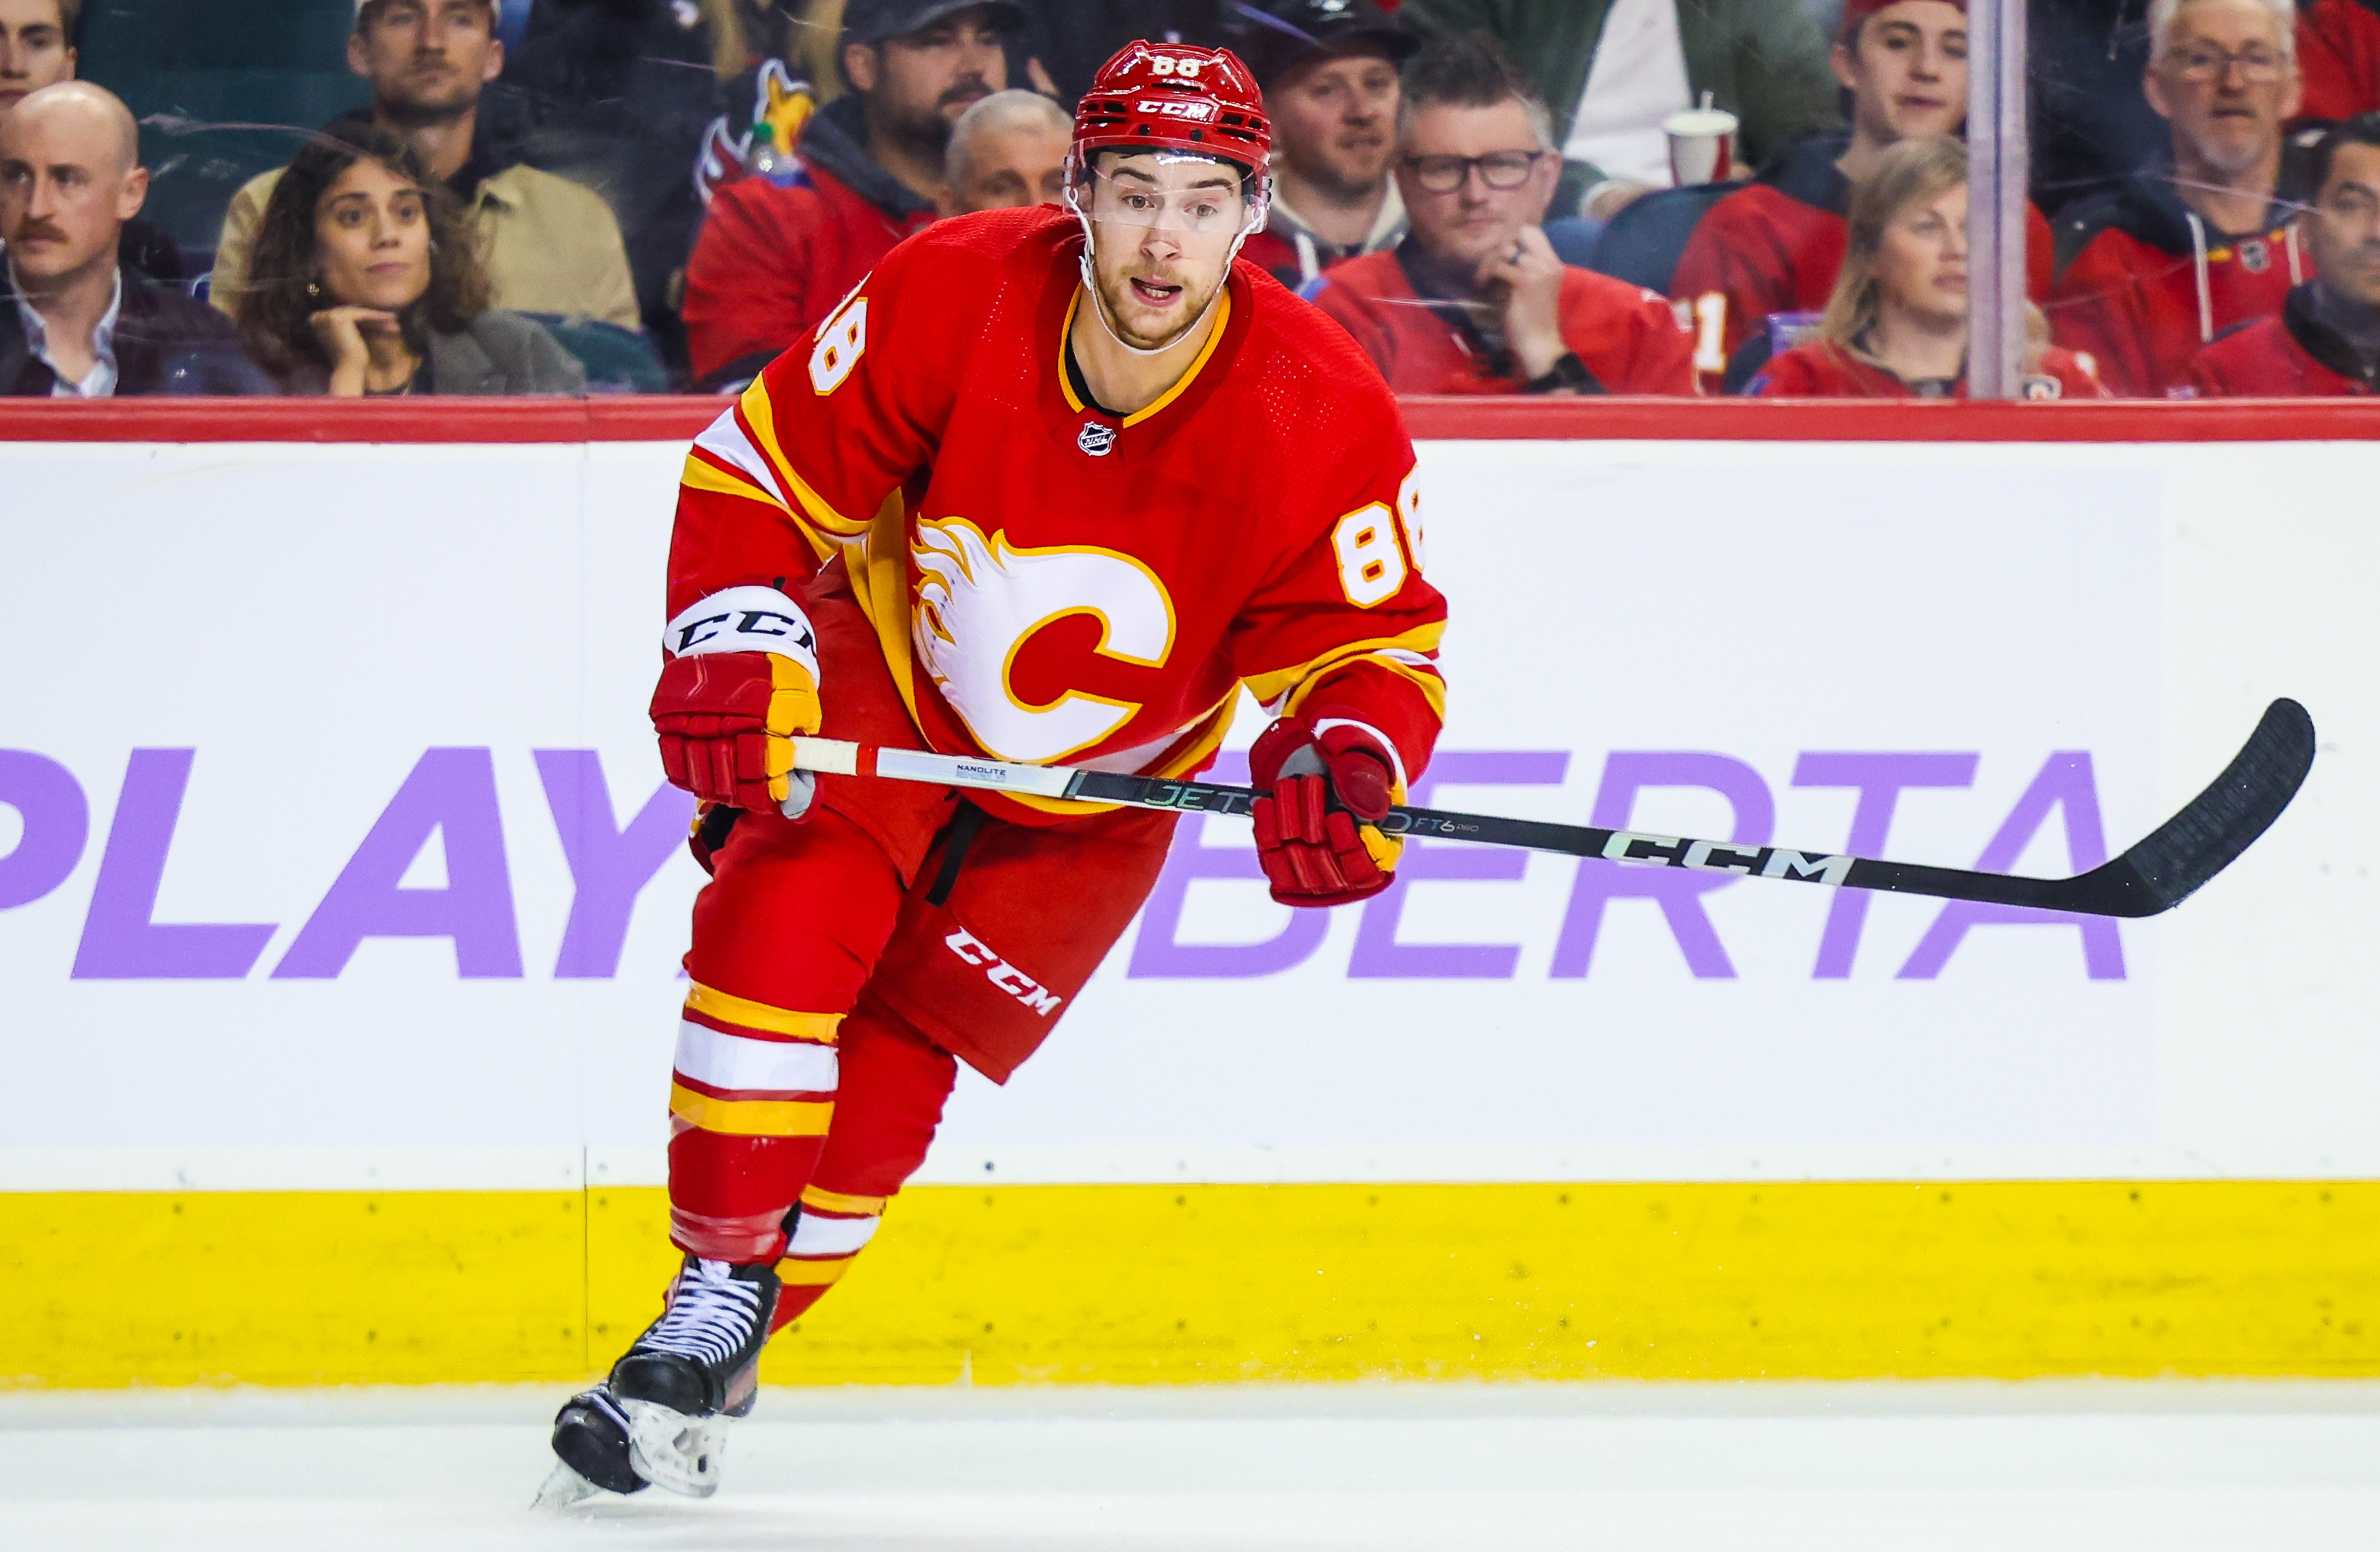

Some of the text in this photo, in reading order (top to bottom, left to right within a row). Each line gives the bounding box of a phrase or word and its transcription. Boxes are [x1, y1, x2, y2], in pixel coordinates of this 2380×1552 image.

[1152, 56, 1201, 77] 88
[1137, 100, 1212, 120] CCM
[809, 270, 869, 396] 8
[957, 764, 1007, 776] NANOLITE
[1601, 831, 1855, 886] CCM
[945, 925, 1062, 1016] CCM
